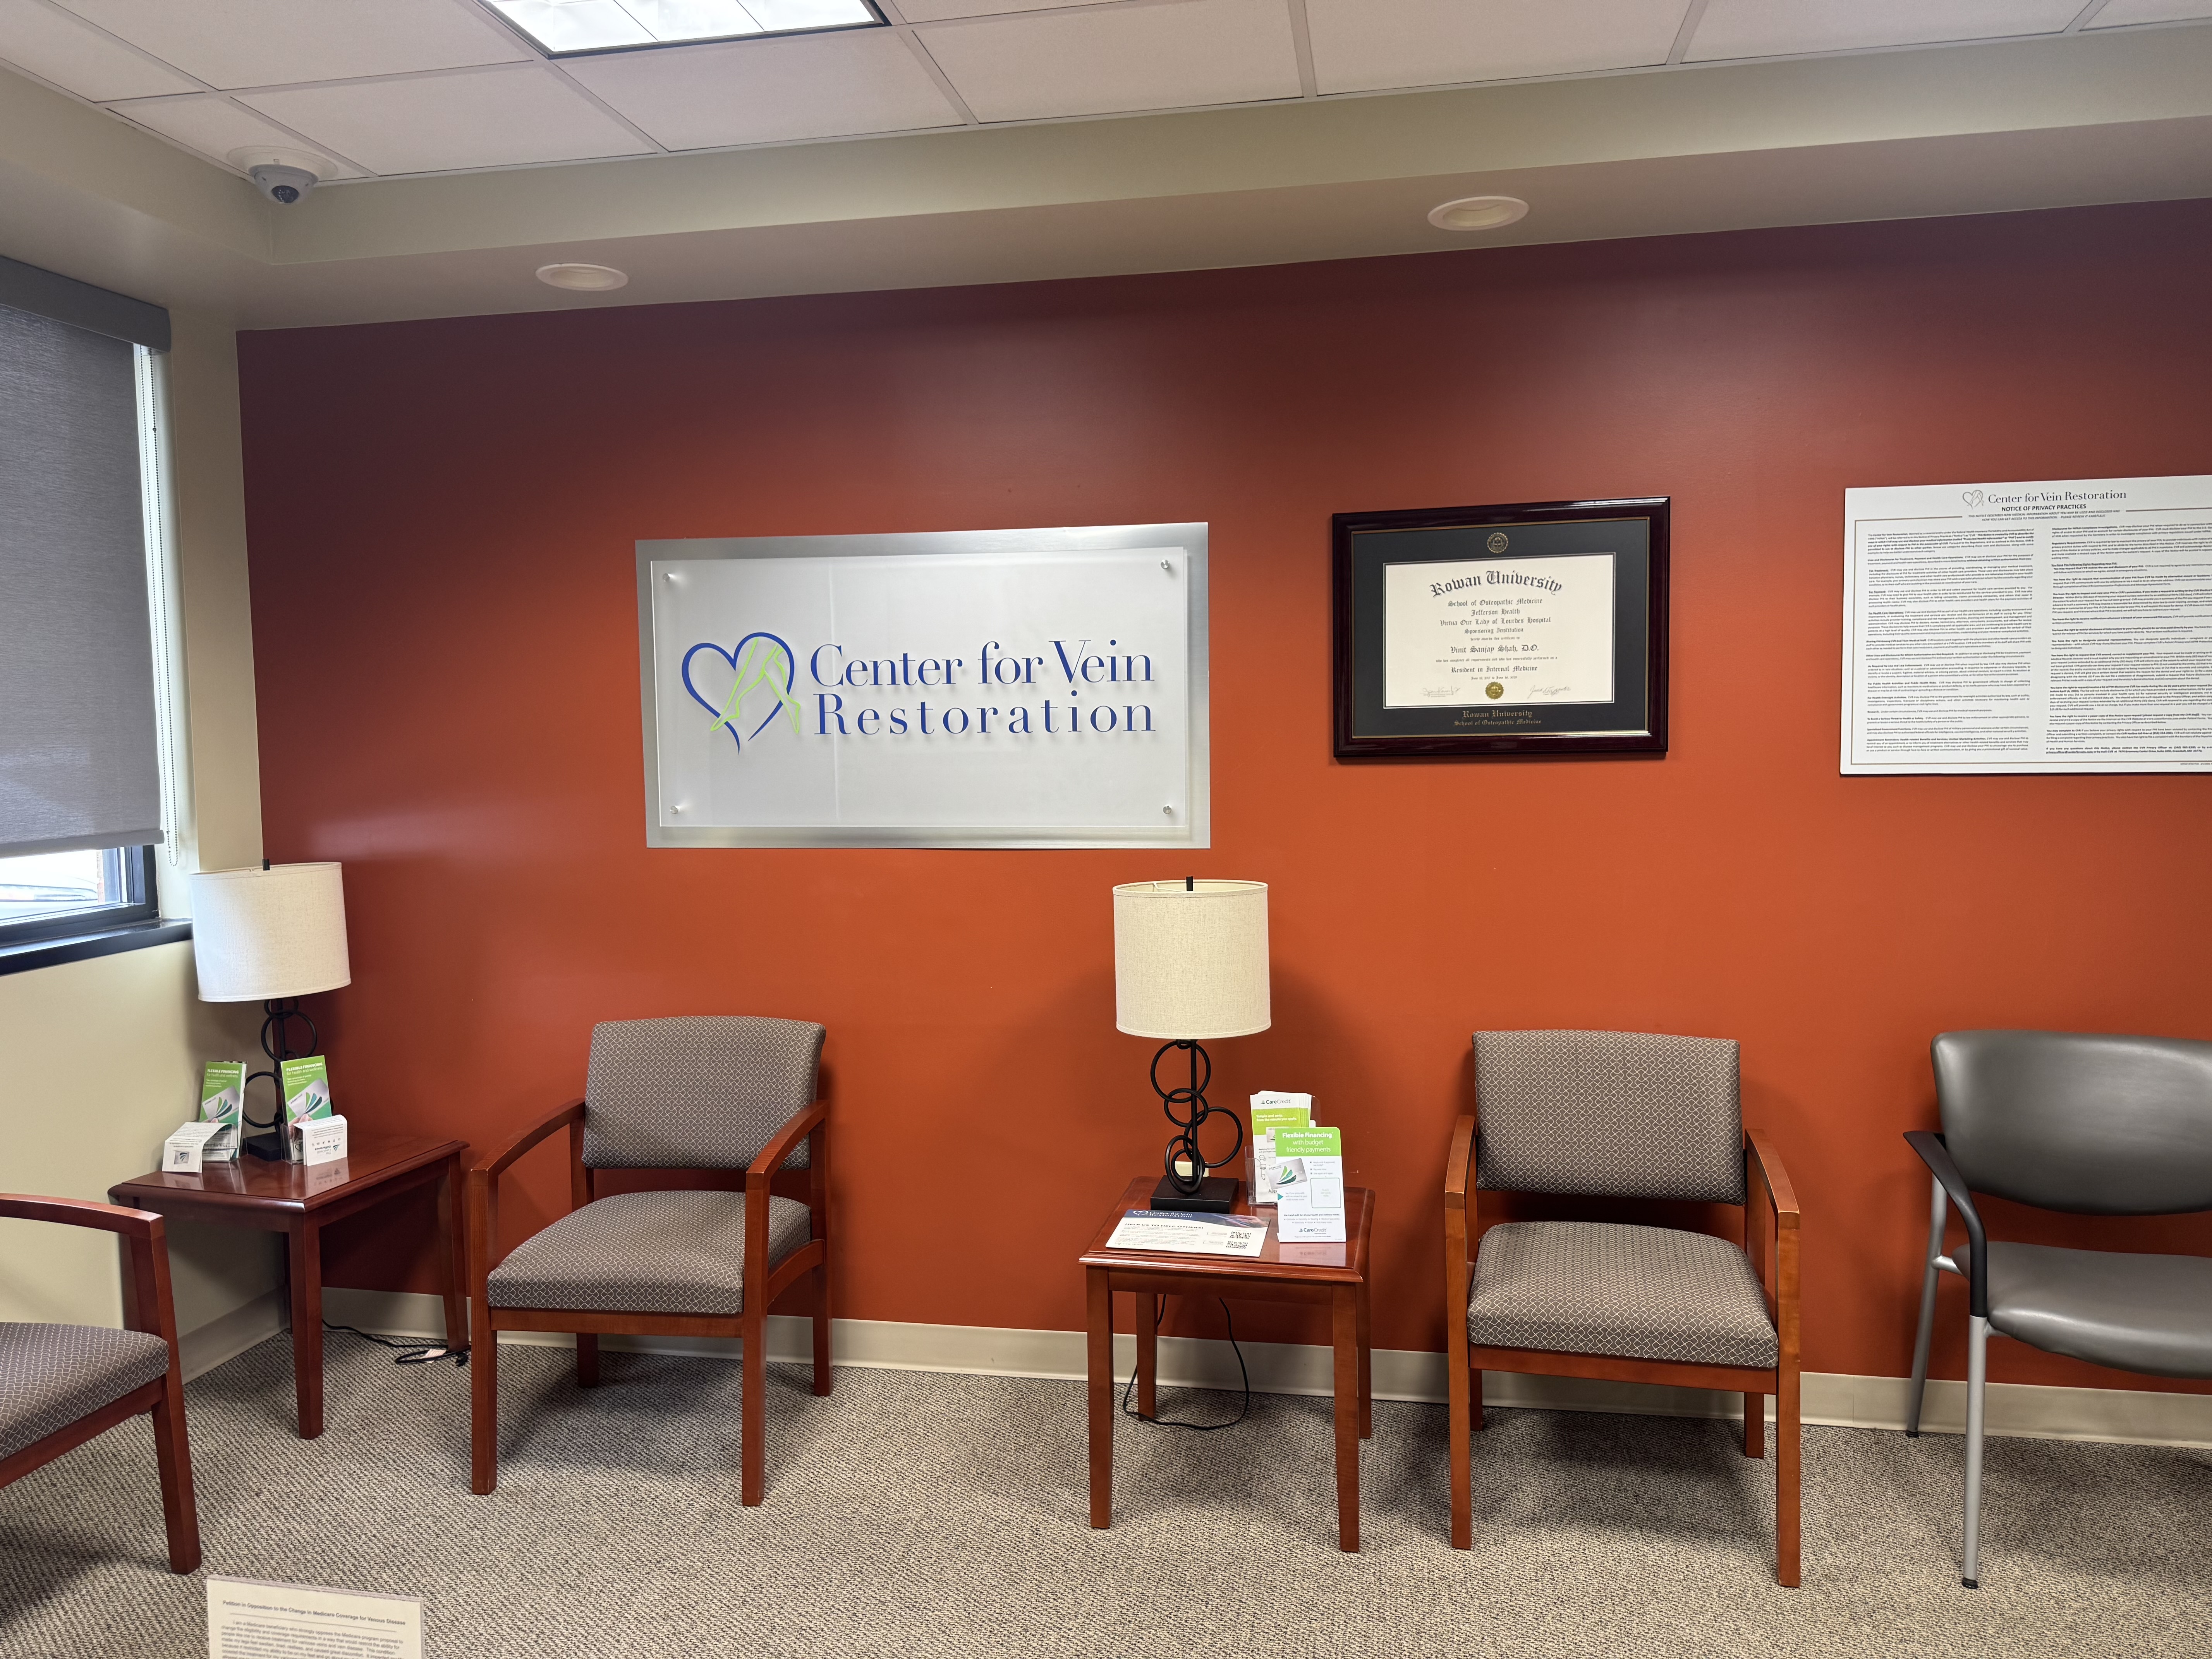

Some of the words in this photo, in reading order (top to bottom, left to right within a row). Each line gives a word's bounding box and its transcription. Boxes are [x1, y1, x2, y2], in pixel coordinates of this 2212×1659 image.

[1989, 494, 2022, 503] Center
[2025, 493, 2039, 502] for
[2040, 492, 2061, 501] Vein
[2065, 490, 2126, 500] Restoration
[1429, 575, 1482, 598] Rowan
[1486, 570, 1562, 596] University
[810, 644, 962, 687] Center
[978, 641, 1043, 685] for
[1049, 639, 1155, 683] Vein
[814, 690, 1156, 735] Restoration
[1462, 711, 1489, 719] Rowan
[1491, 710, 1532, 719] University
[247, 1602, 273, 1611] Opposition
